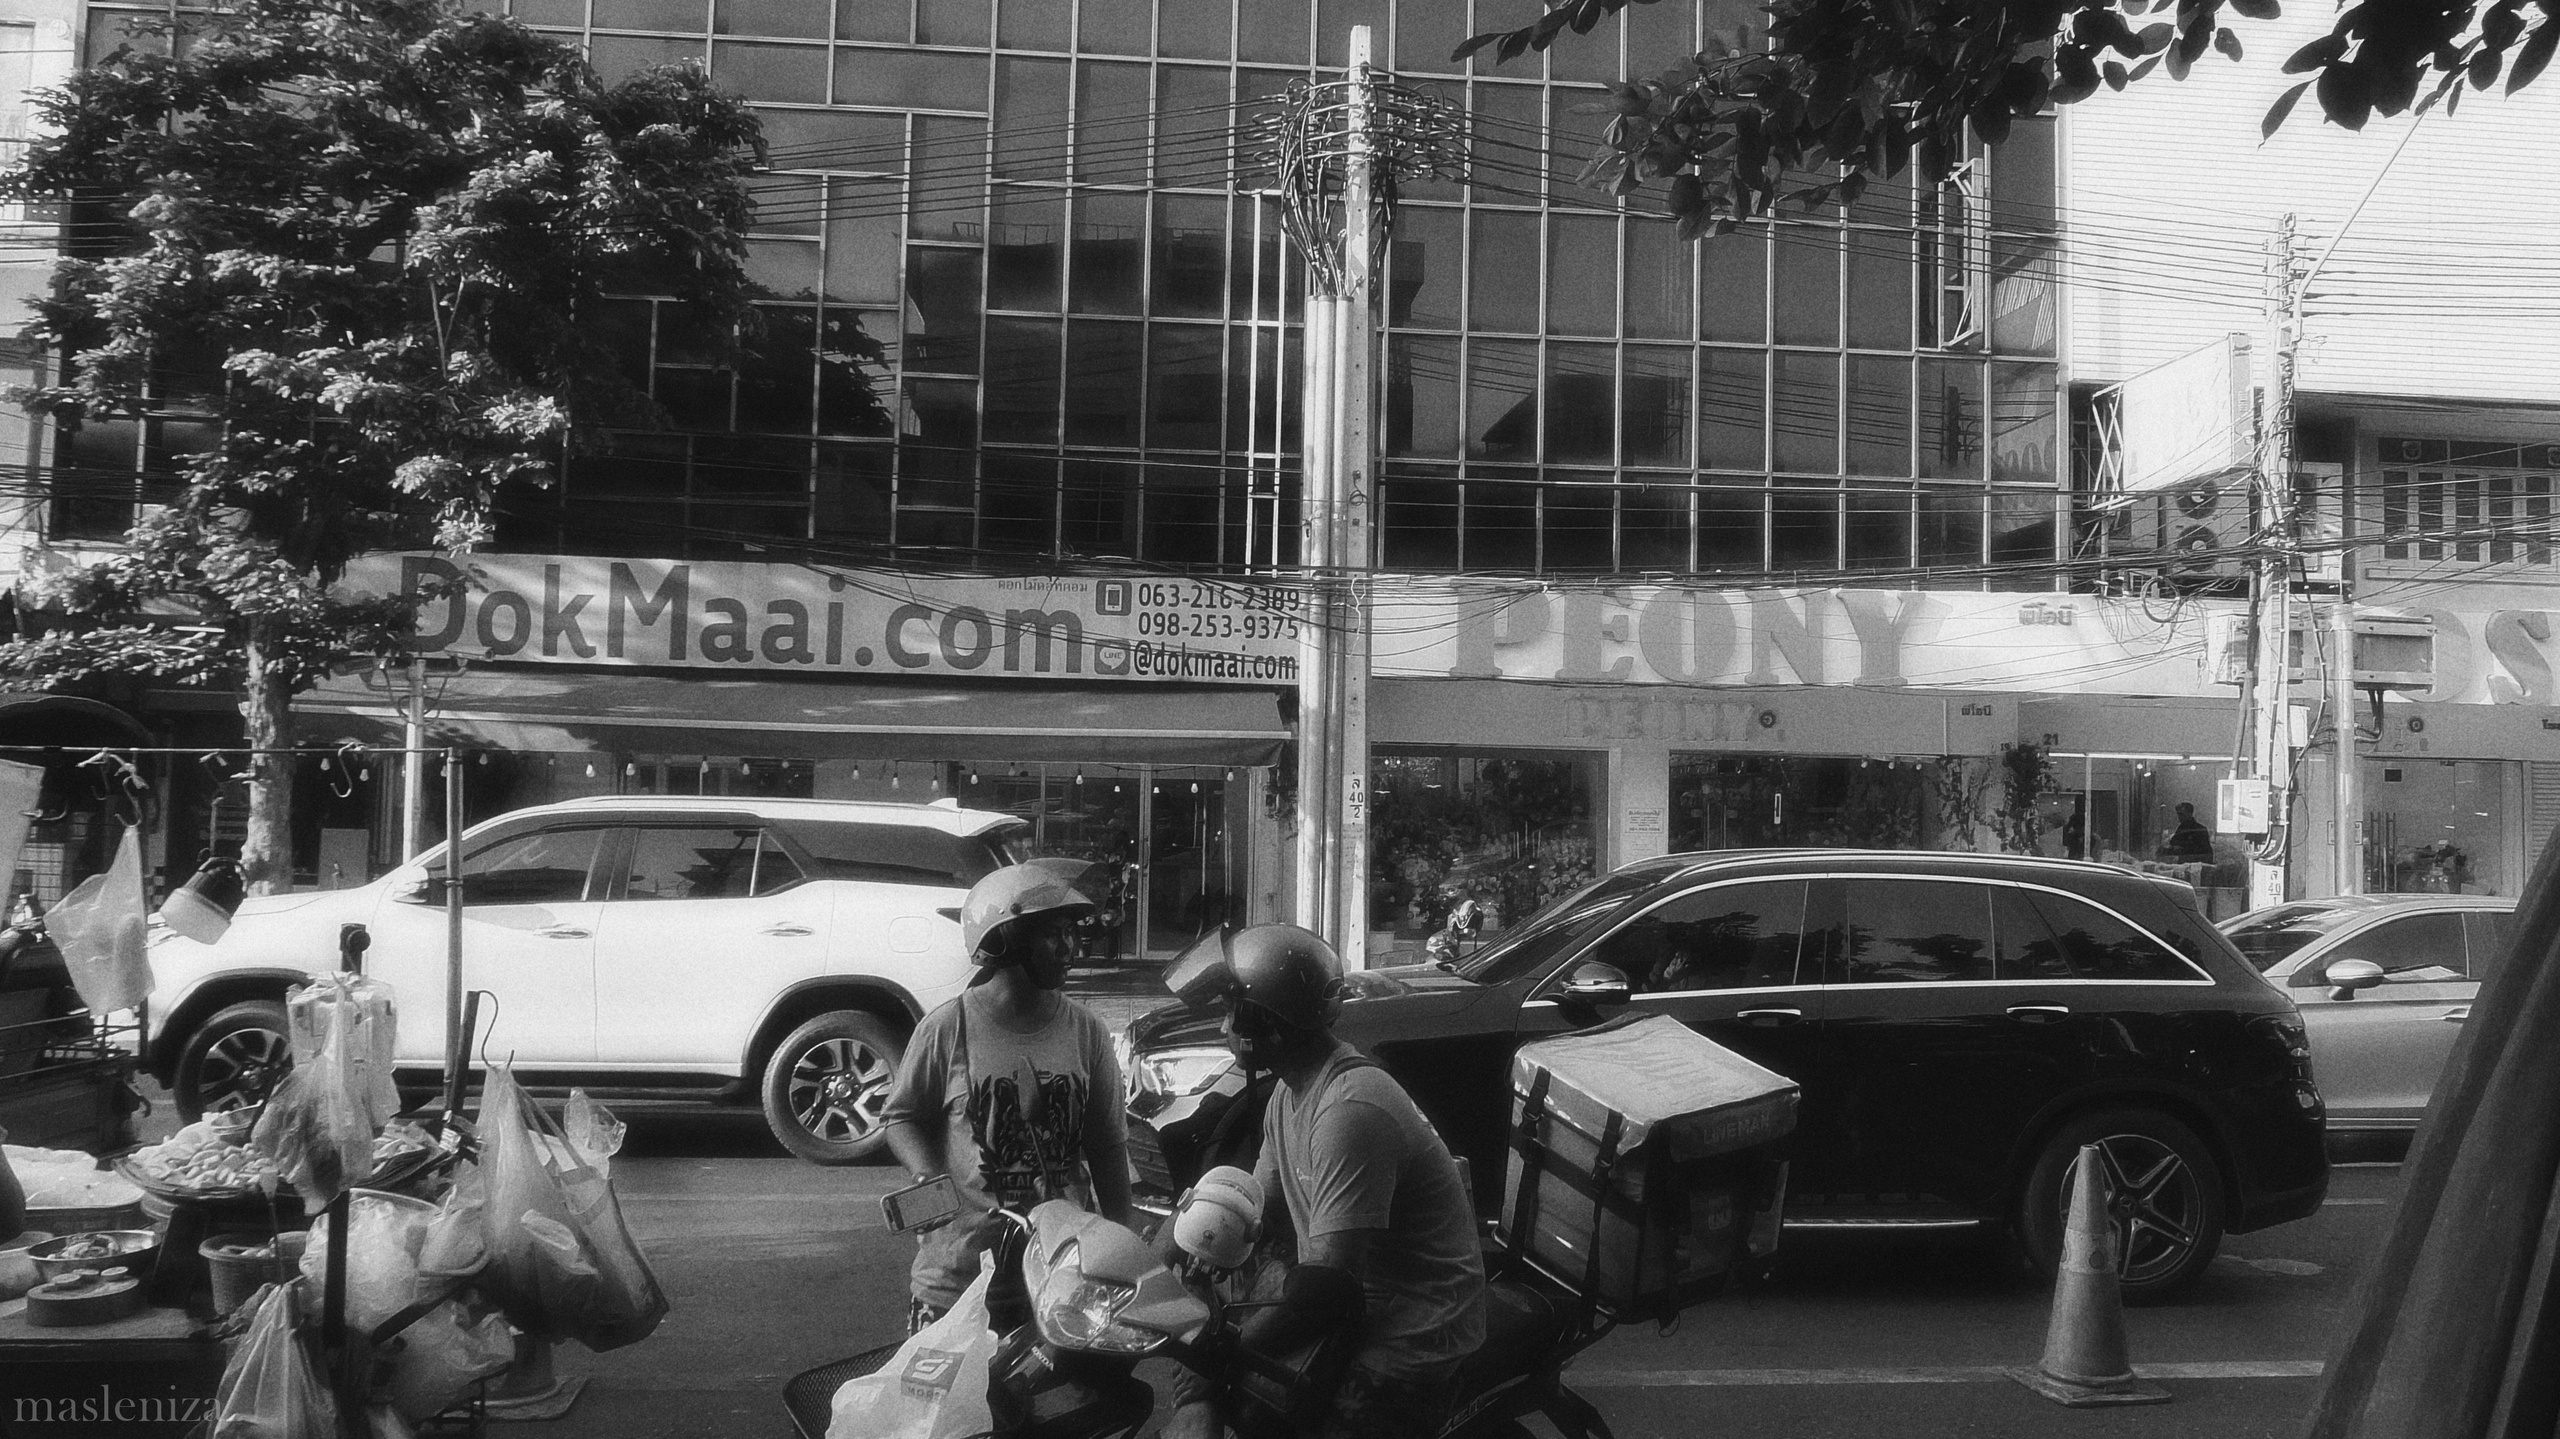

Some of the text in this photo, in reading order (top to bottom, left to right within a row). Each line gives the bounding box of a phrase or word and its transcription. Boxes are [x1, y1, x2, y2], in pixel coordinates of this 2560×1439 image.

[1138, 583, 1299, 611] 063-216-2389
[400, 556, 1083, 674] DokMaai.com
[1138, 612, 1299, 639] 098-253-9375
[1449, 582, 1950, 686] PEONY
[1103, 652, 1123, 660] LINE
[1134, 640, 1296, 680] @dokmaai.com
[1349, 792, 1364, 803] 40
[1354, 807, 1360, 818] 2
